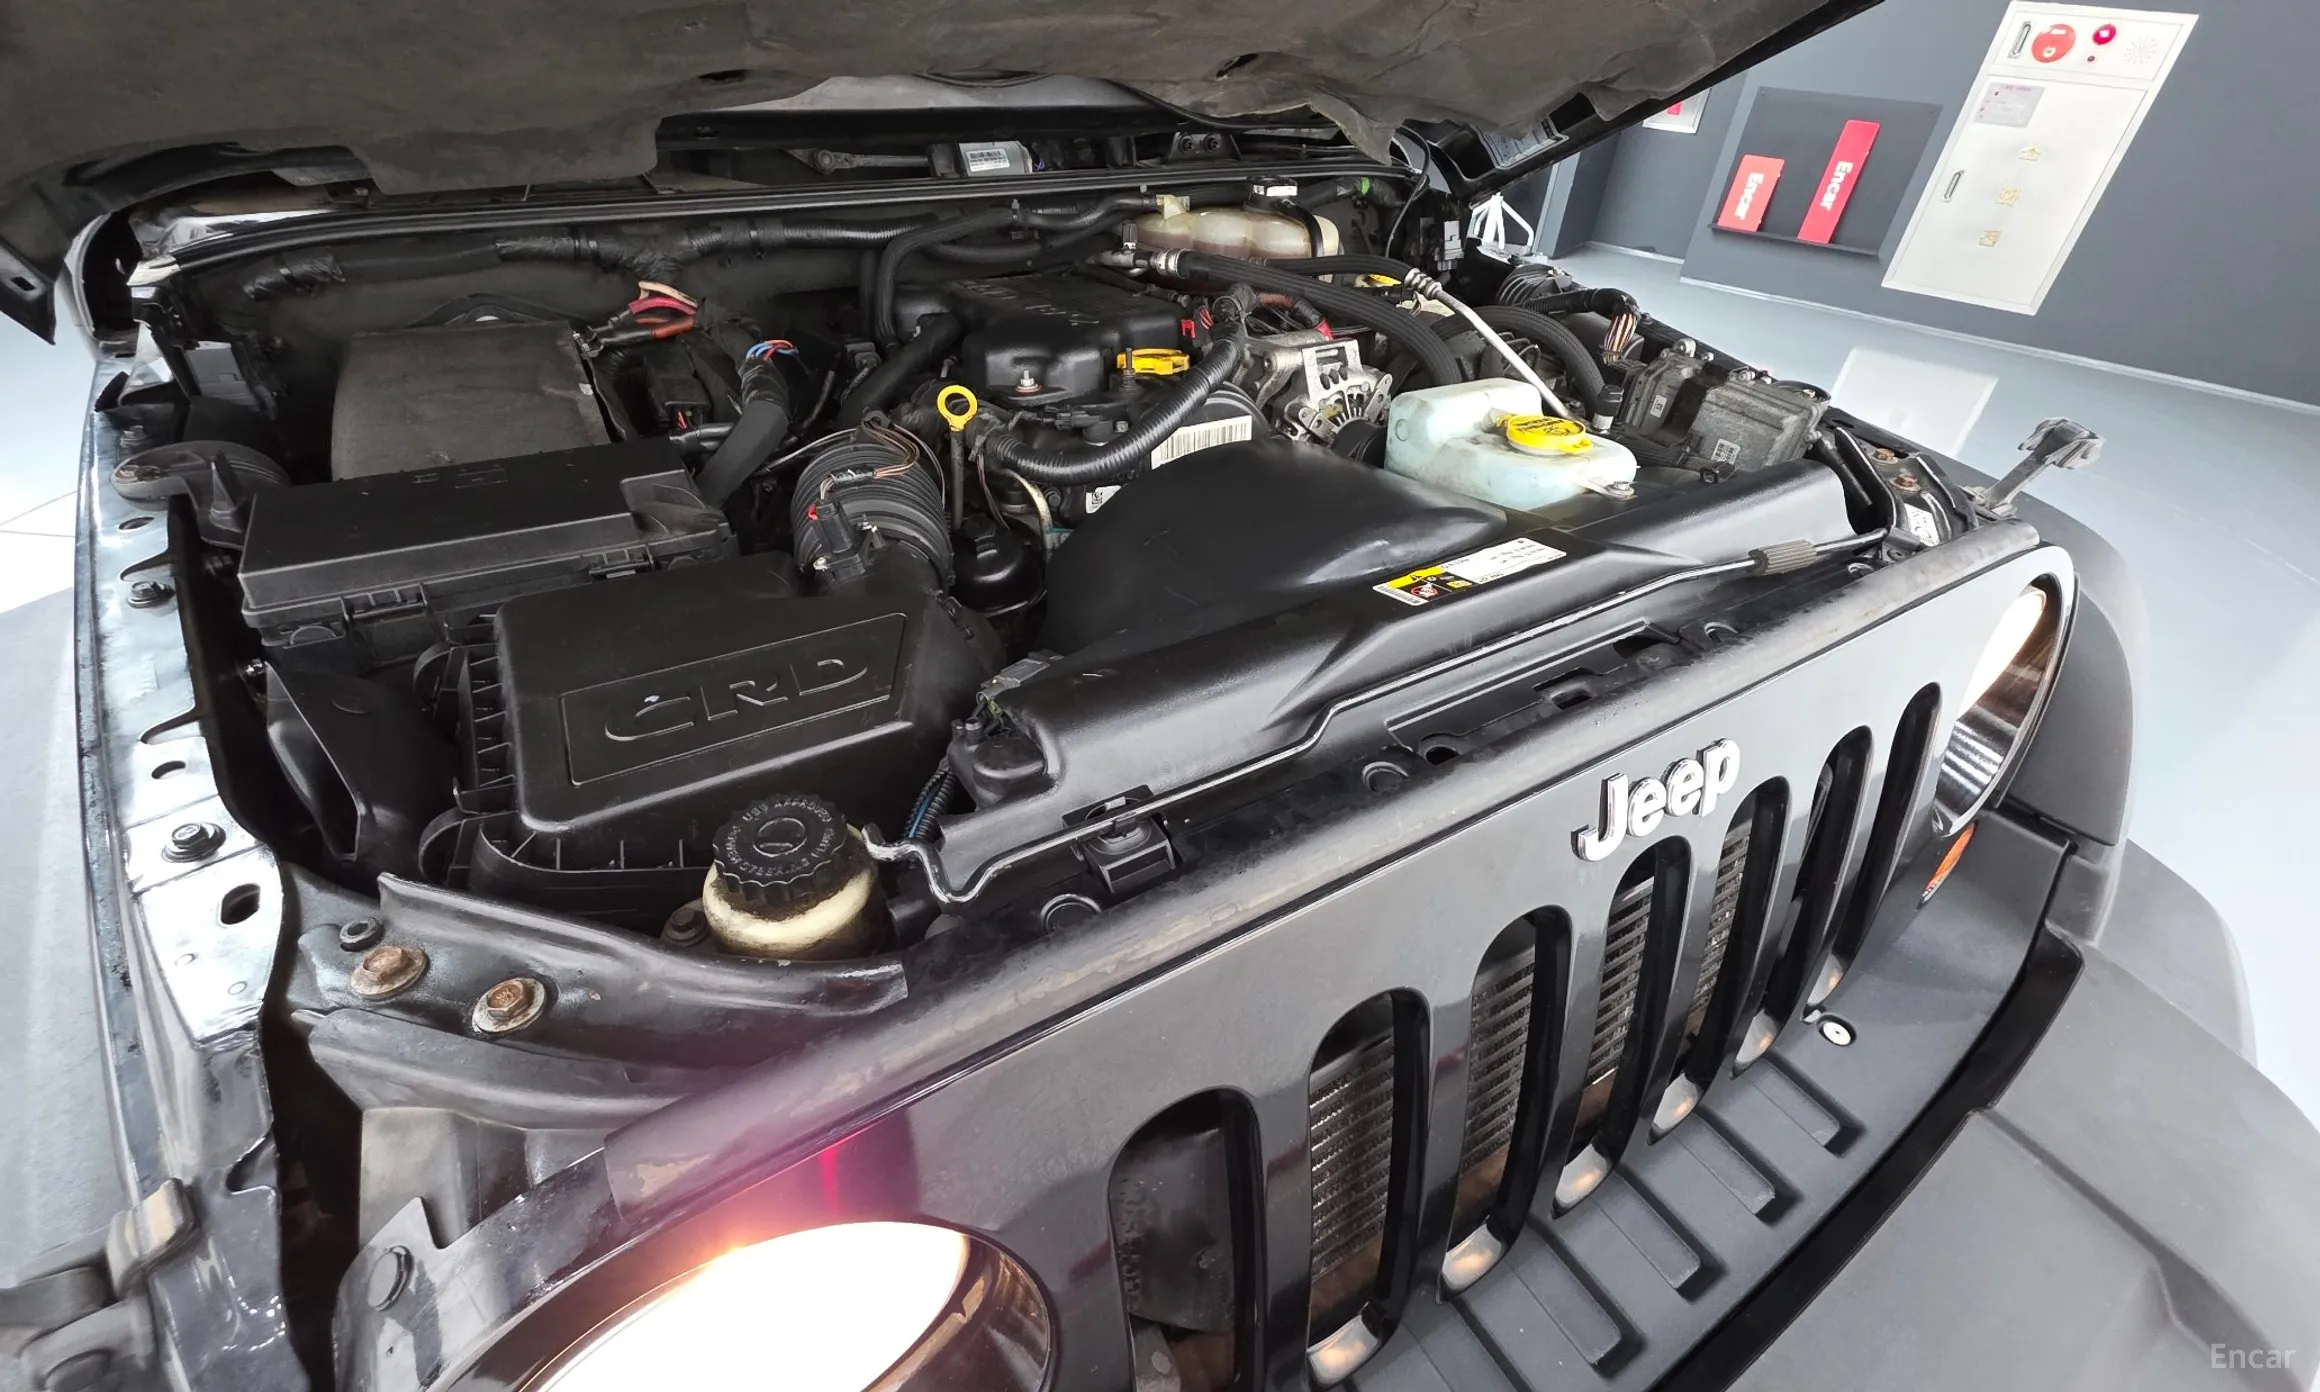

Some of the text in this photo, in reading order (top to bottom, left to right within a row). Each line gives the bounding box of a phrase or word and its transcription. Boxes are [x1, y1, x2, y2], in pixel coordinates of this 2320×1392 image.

[1820, 161, 1854, 211] Encar
[603, 653, 869, 742] CRD
[1571, 737, 1741, 862] Jeep
